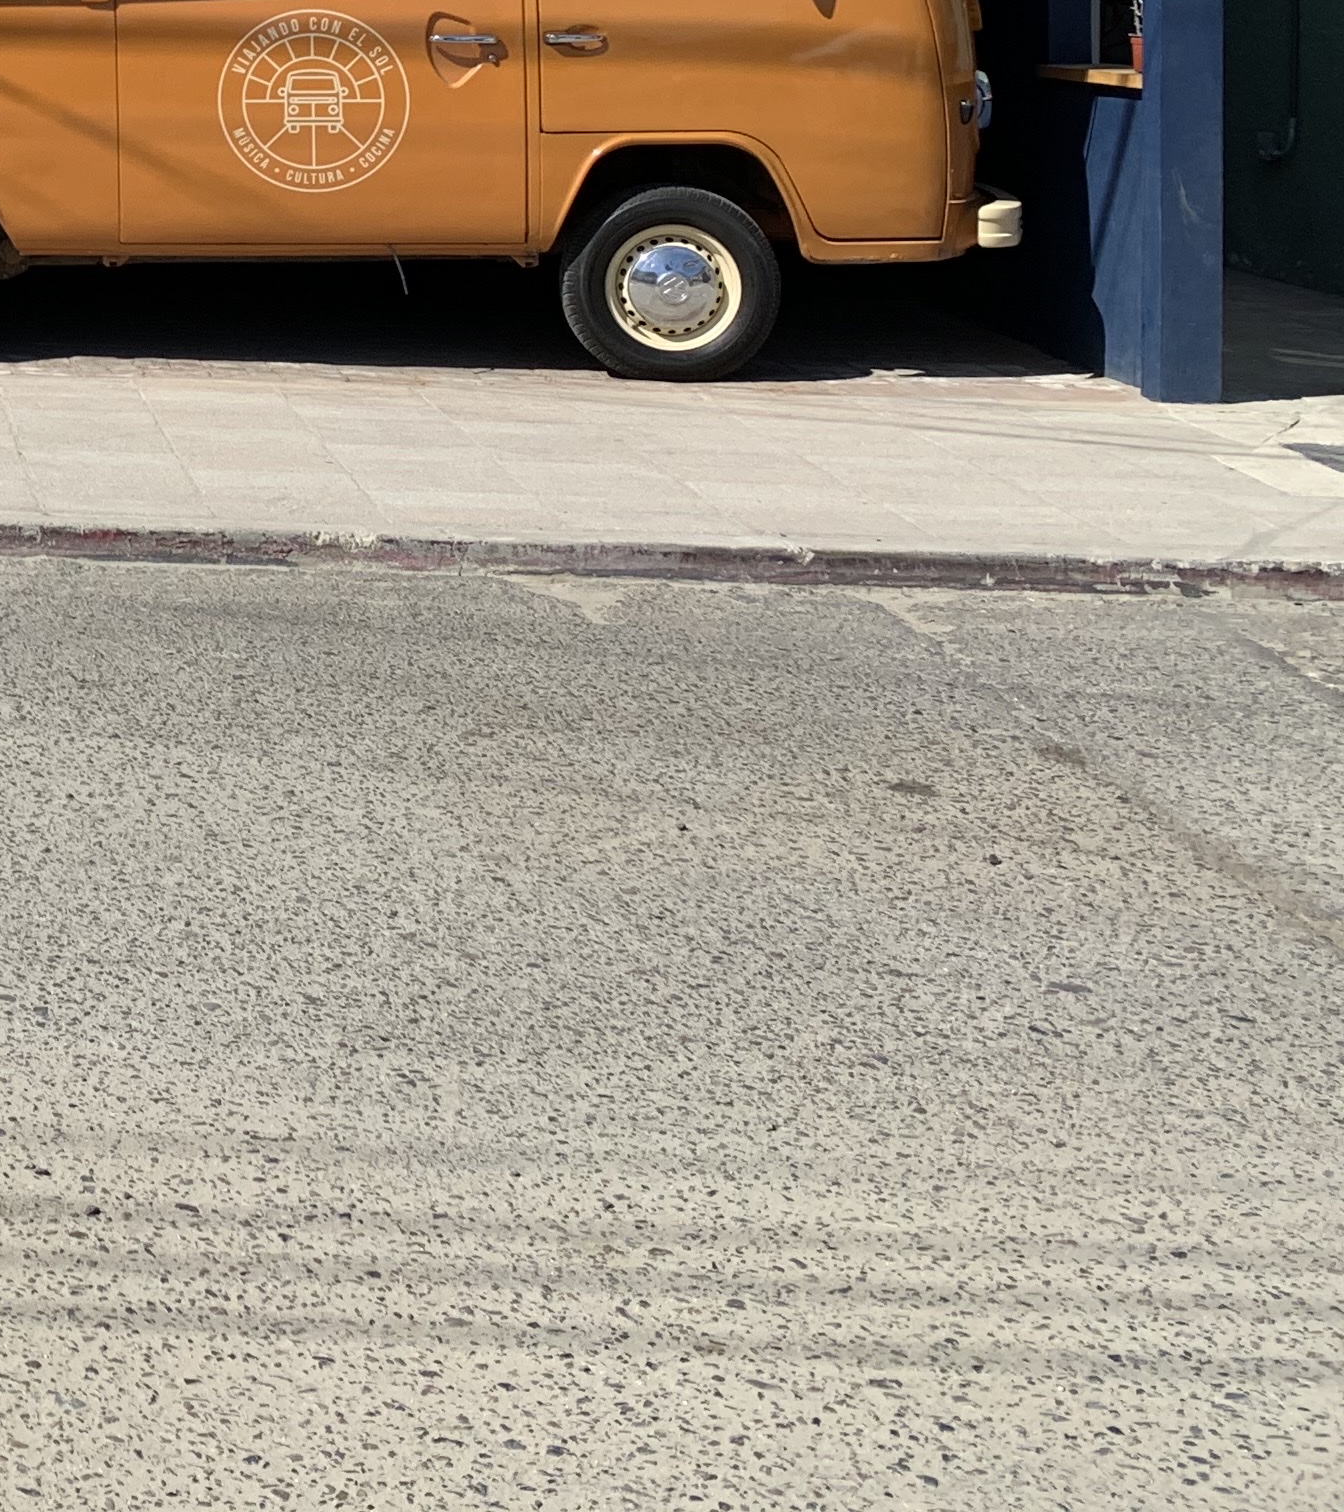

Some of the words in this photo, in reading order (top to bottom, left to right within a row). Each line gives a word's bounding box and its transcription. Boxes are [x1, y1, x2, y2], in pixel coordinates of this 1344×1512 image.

[231, 18, 300, 75] VIAJANDO
[308, 16, 343, 34] CON
[347, 27, 365, 47] EL
[368, 45, 395, 77] SOL
[232, 127, 270, 170] MÚSICA
[285, 169, 345, 185] CULTURA
[358, 128, 396, 169] COCINA
